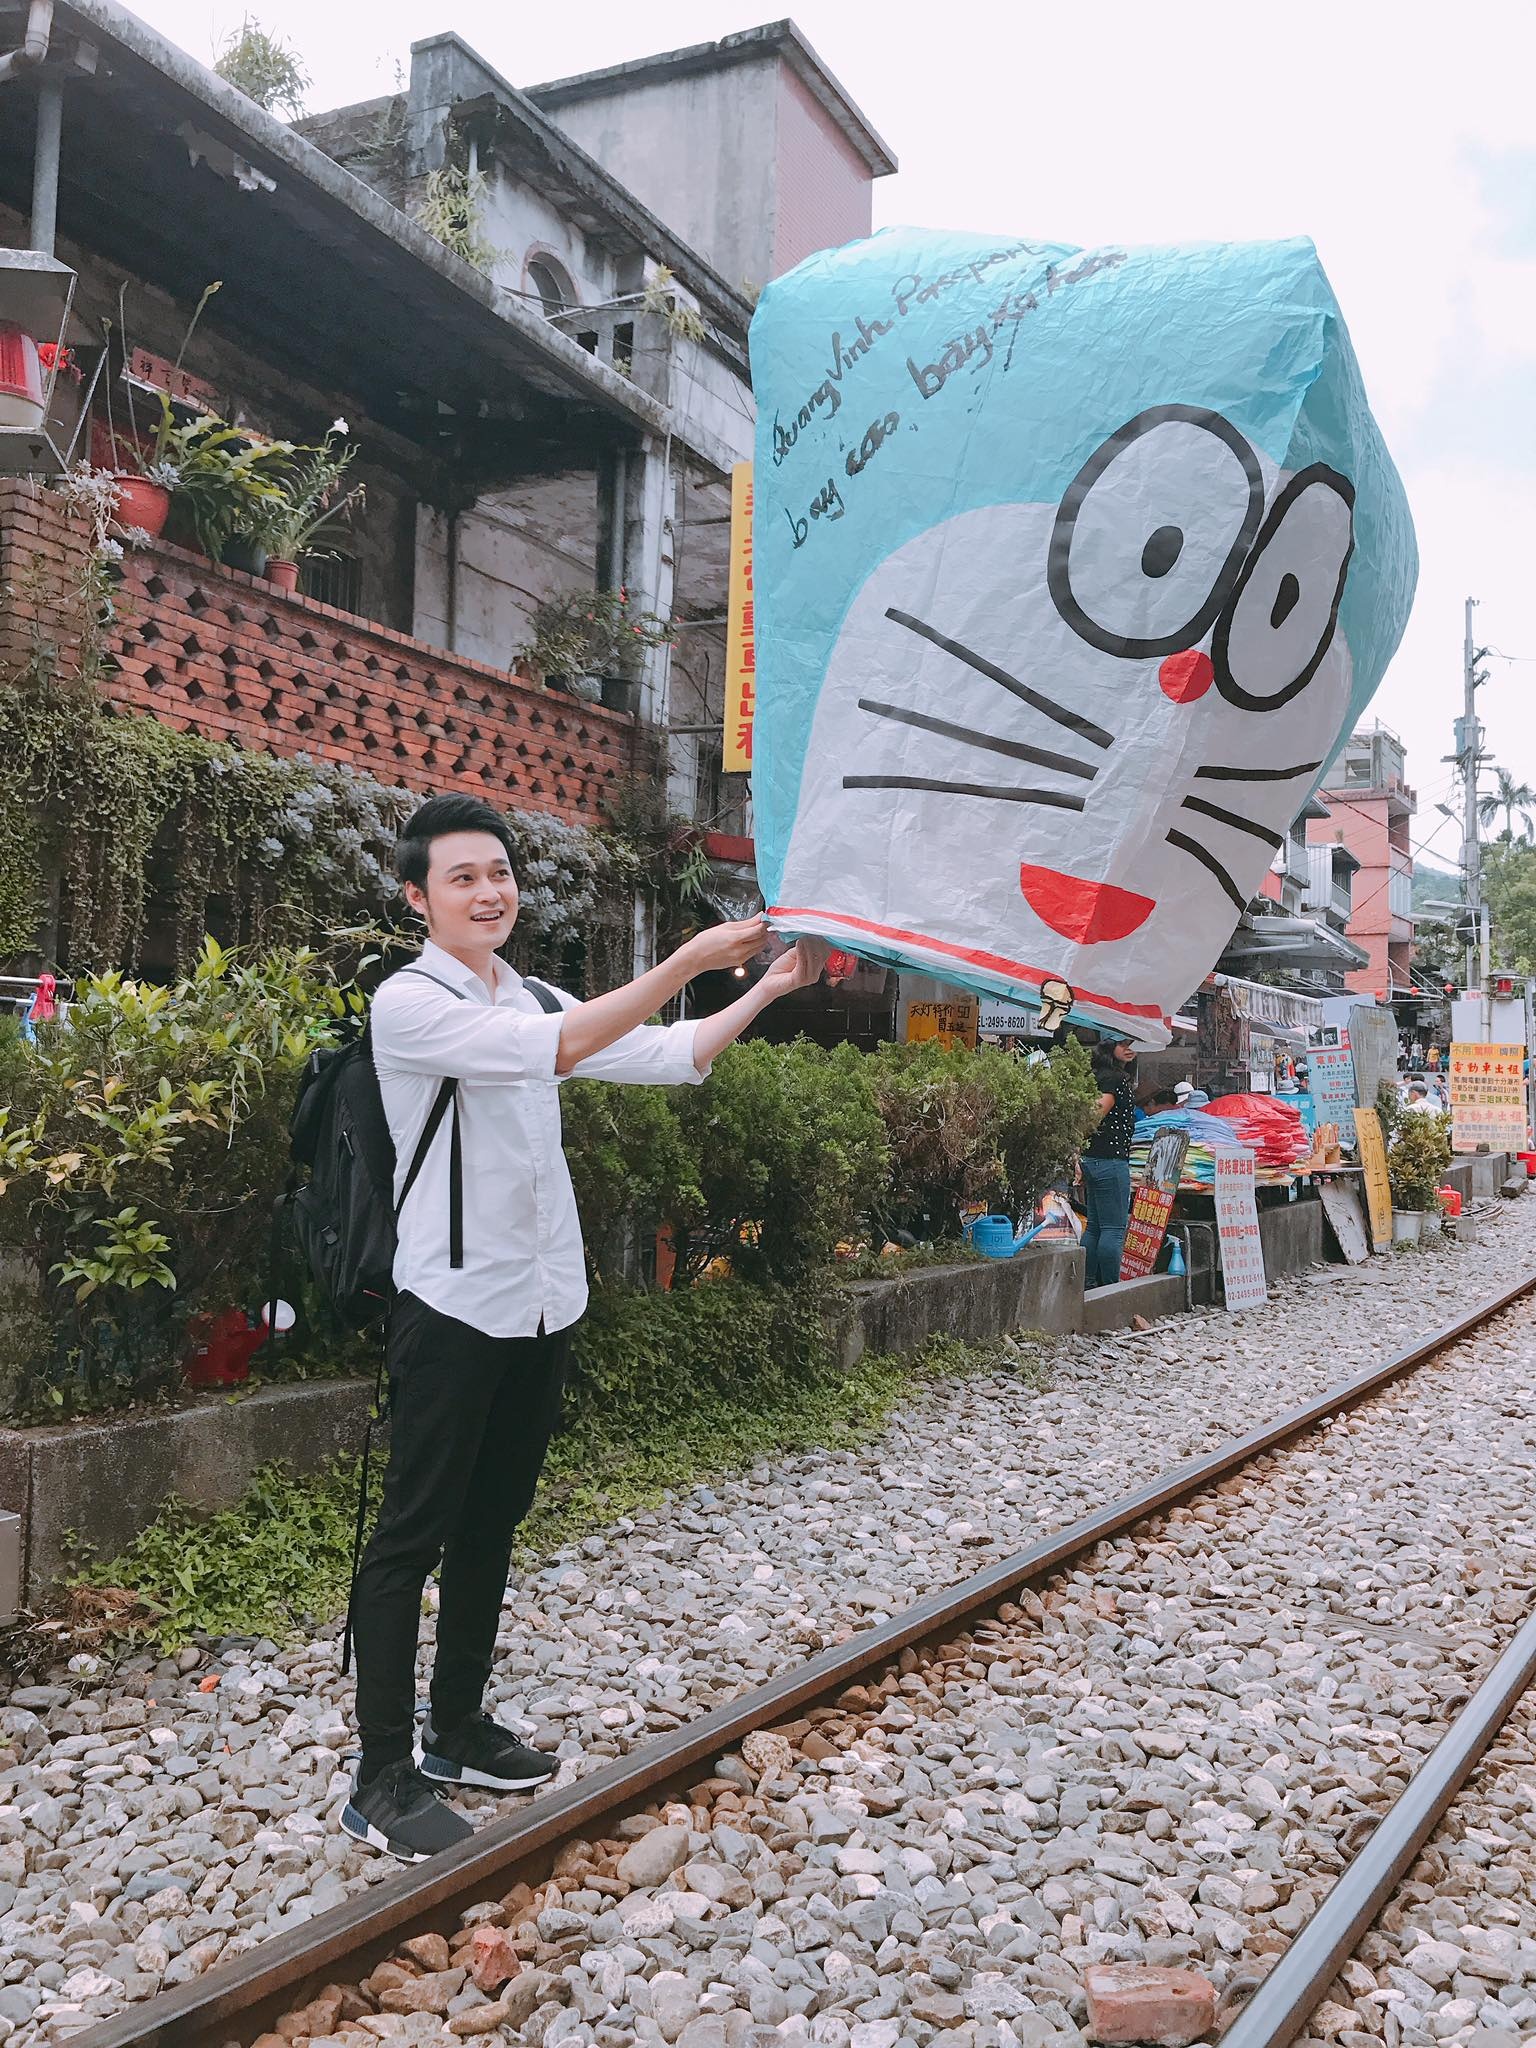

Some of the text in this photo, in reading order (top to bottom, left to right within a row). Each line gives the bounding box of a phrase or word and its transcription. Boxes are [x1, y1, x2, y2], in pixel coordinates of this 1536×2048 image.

[826, 315, 895, 381] Vinh
[910, 1003, 954, 1018] 天灯特价
[1453, 1061, 1520, 1075] 電動車出租
